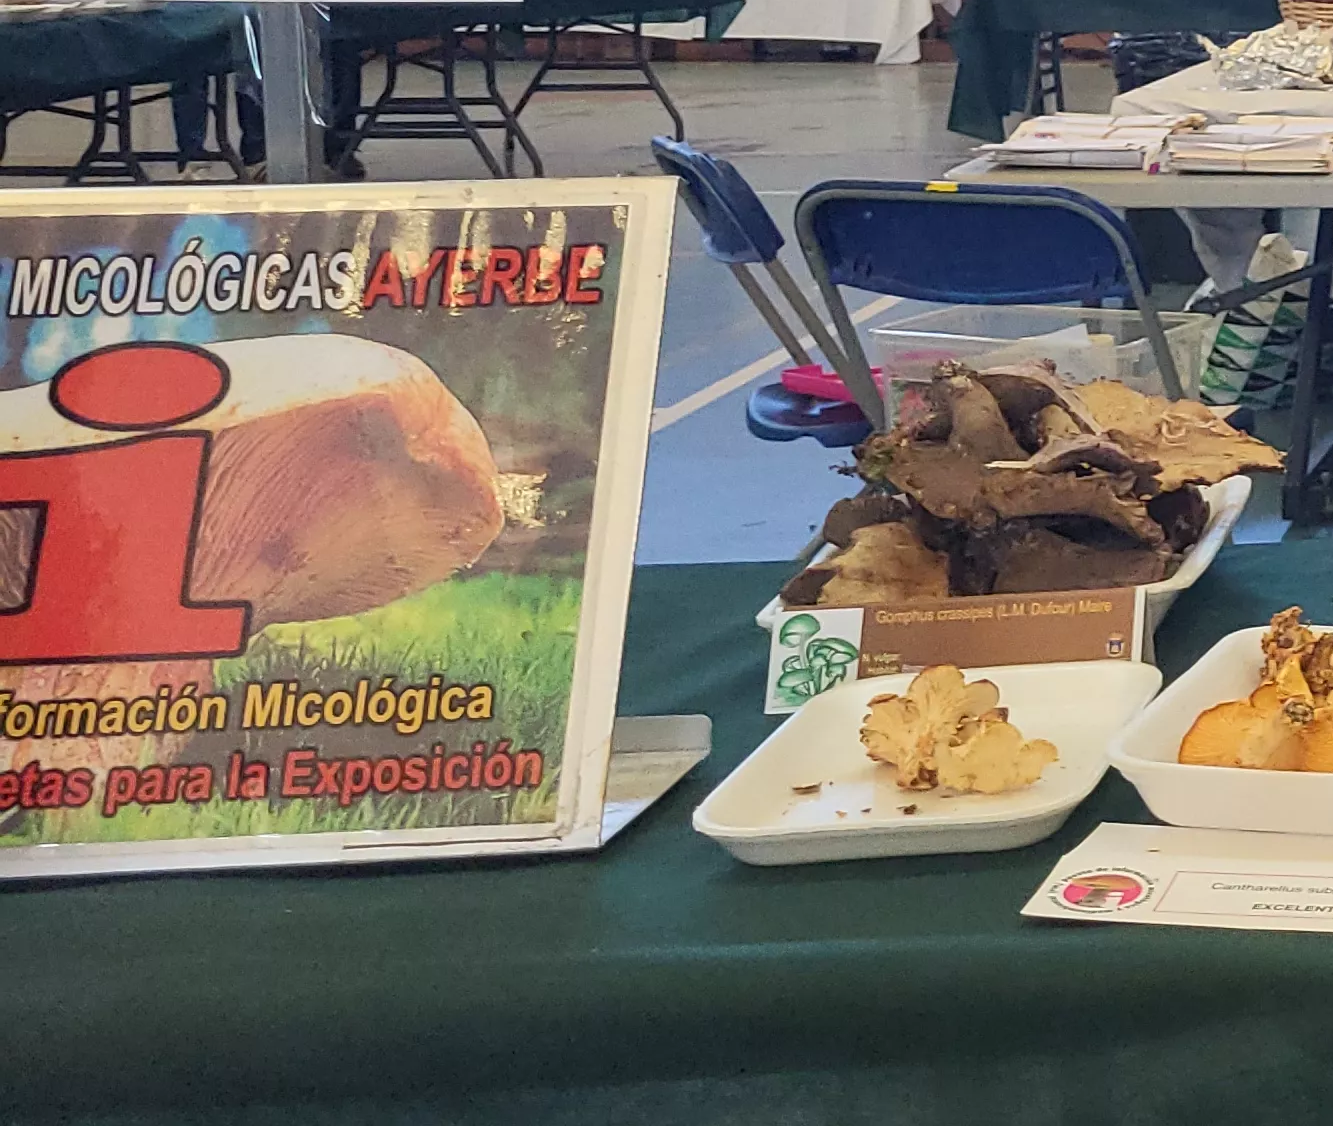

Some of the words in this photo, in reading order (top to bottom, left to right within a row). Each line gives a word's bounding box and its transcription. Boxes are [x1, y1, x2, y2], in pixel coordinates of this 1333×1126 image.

[8, 239, 356, 318] MICOLÓGICAS
[362, 245, 607, 309] AYERBE
[876, 610, 934, 625] Gomphus
[242, 678, 495, 734] Micológica
[102, 763, 213, 817] para
[227, 751, 268, 799] la
[282, 742, 544, 805] Exposición
[1211, 880, 1303, 894] Cantharellus
